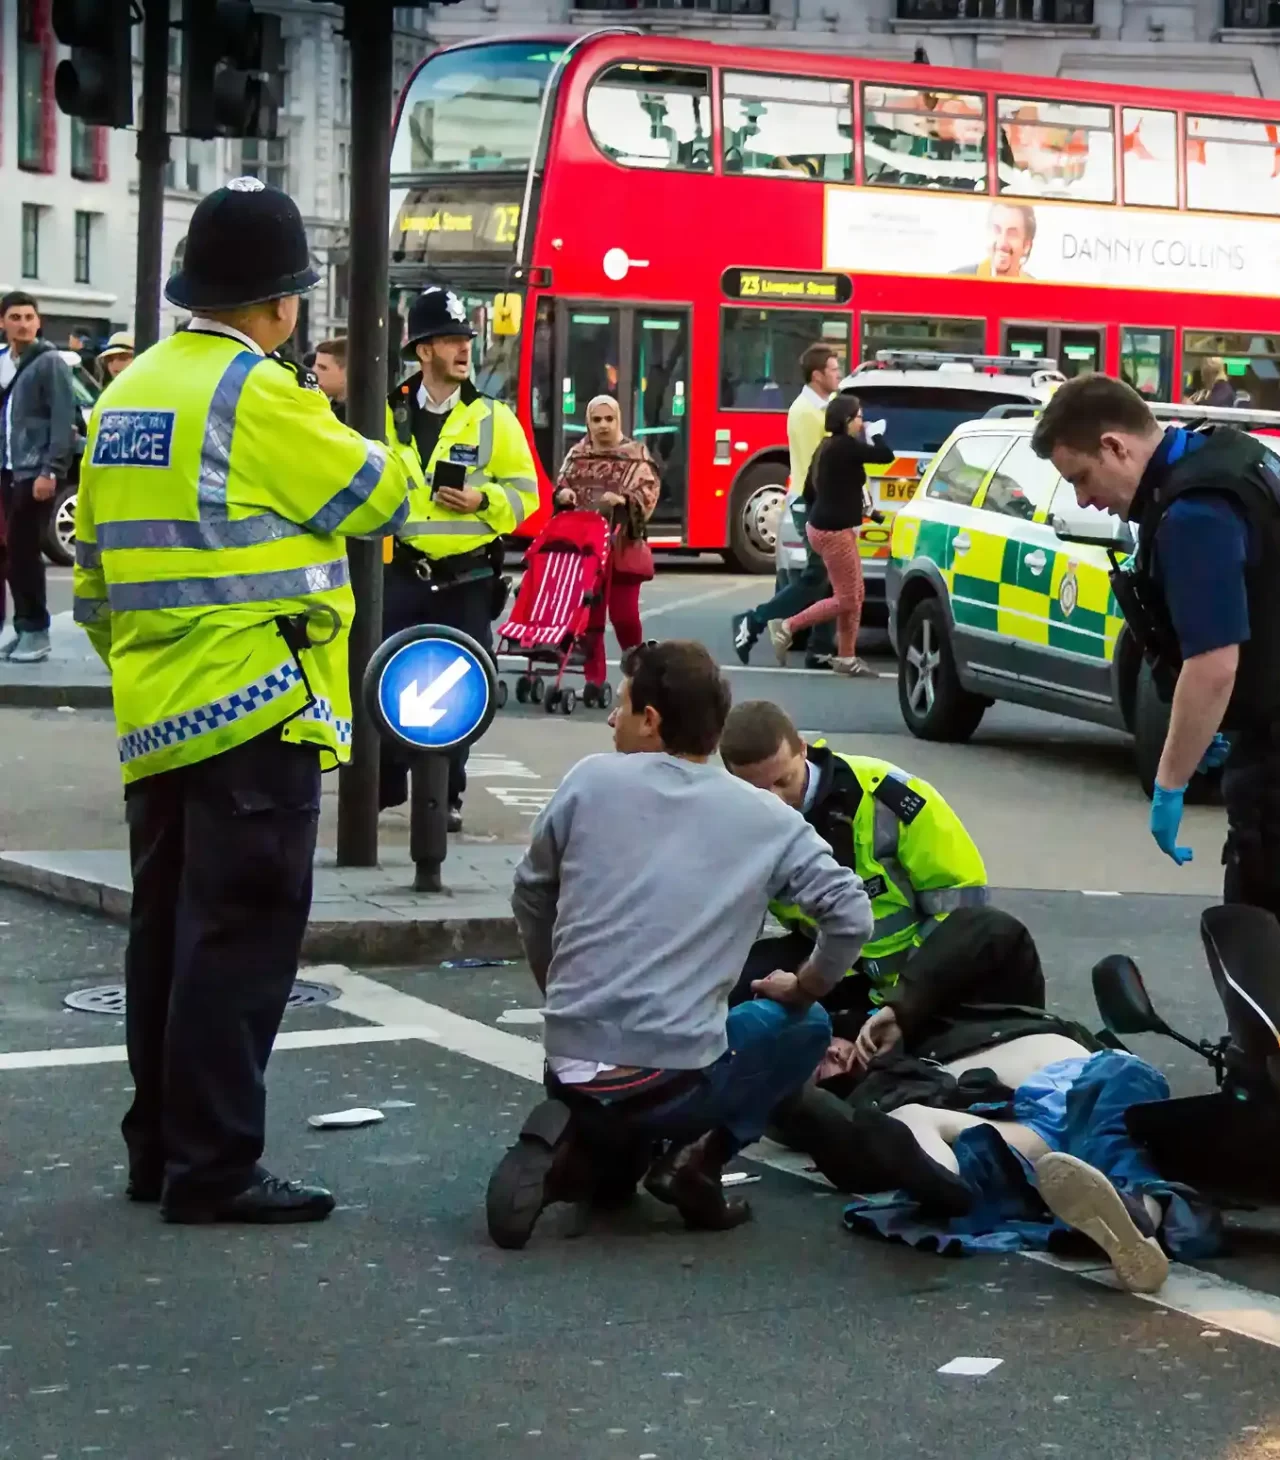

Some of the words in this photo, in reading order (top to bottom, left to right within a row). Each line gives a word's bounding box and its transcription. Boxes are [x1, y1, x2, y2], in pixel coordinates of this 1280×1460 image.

[494, 205, 521, 243] 23
[1062, 233, 1145, 263] DANNY
[1152, 239, 1245, 271] COLLINS
[741, 275, 761, 295] 23
[101, 415, 167, 430] METROPOLTAN
[99, 431, 165, 461] POLICE
